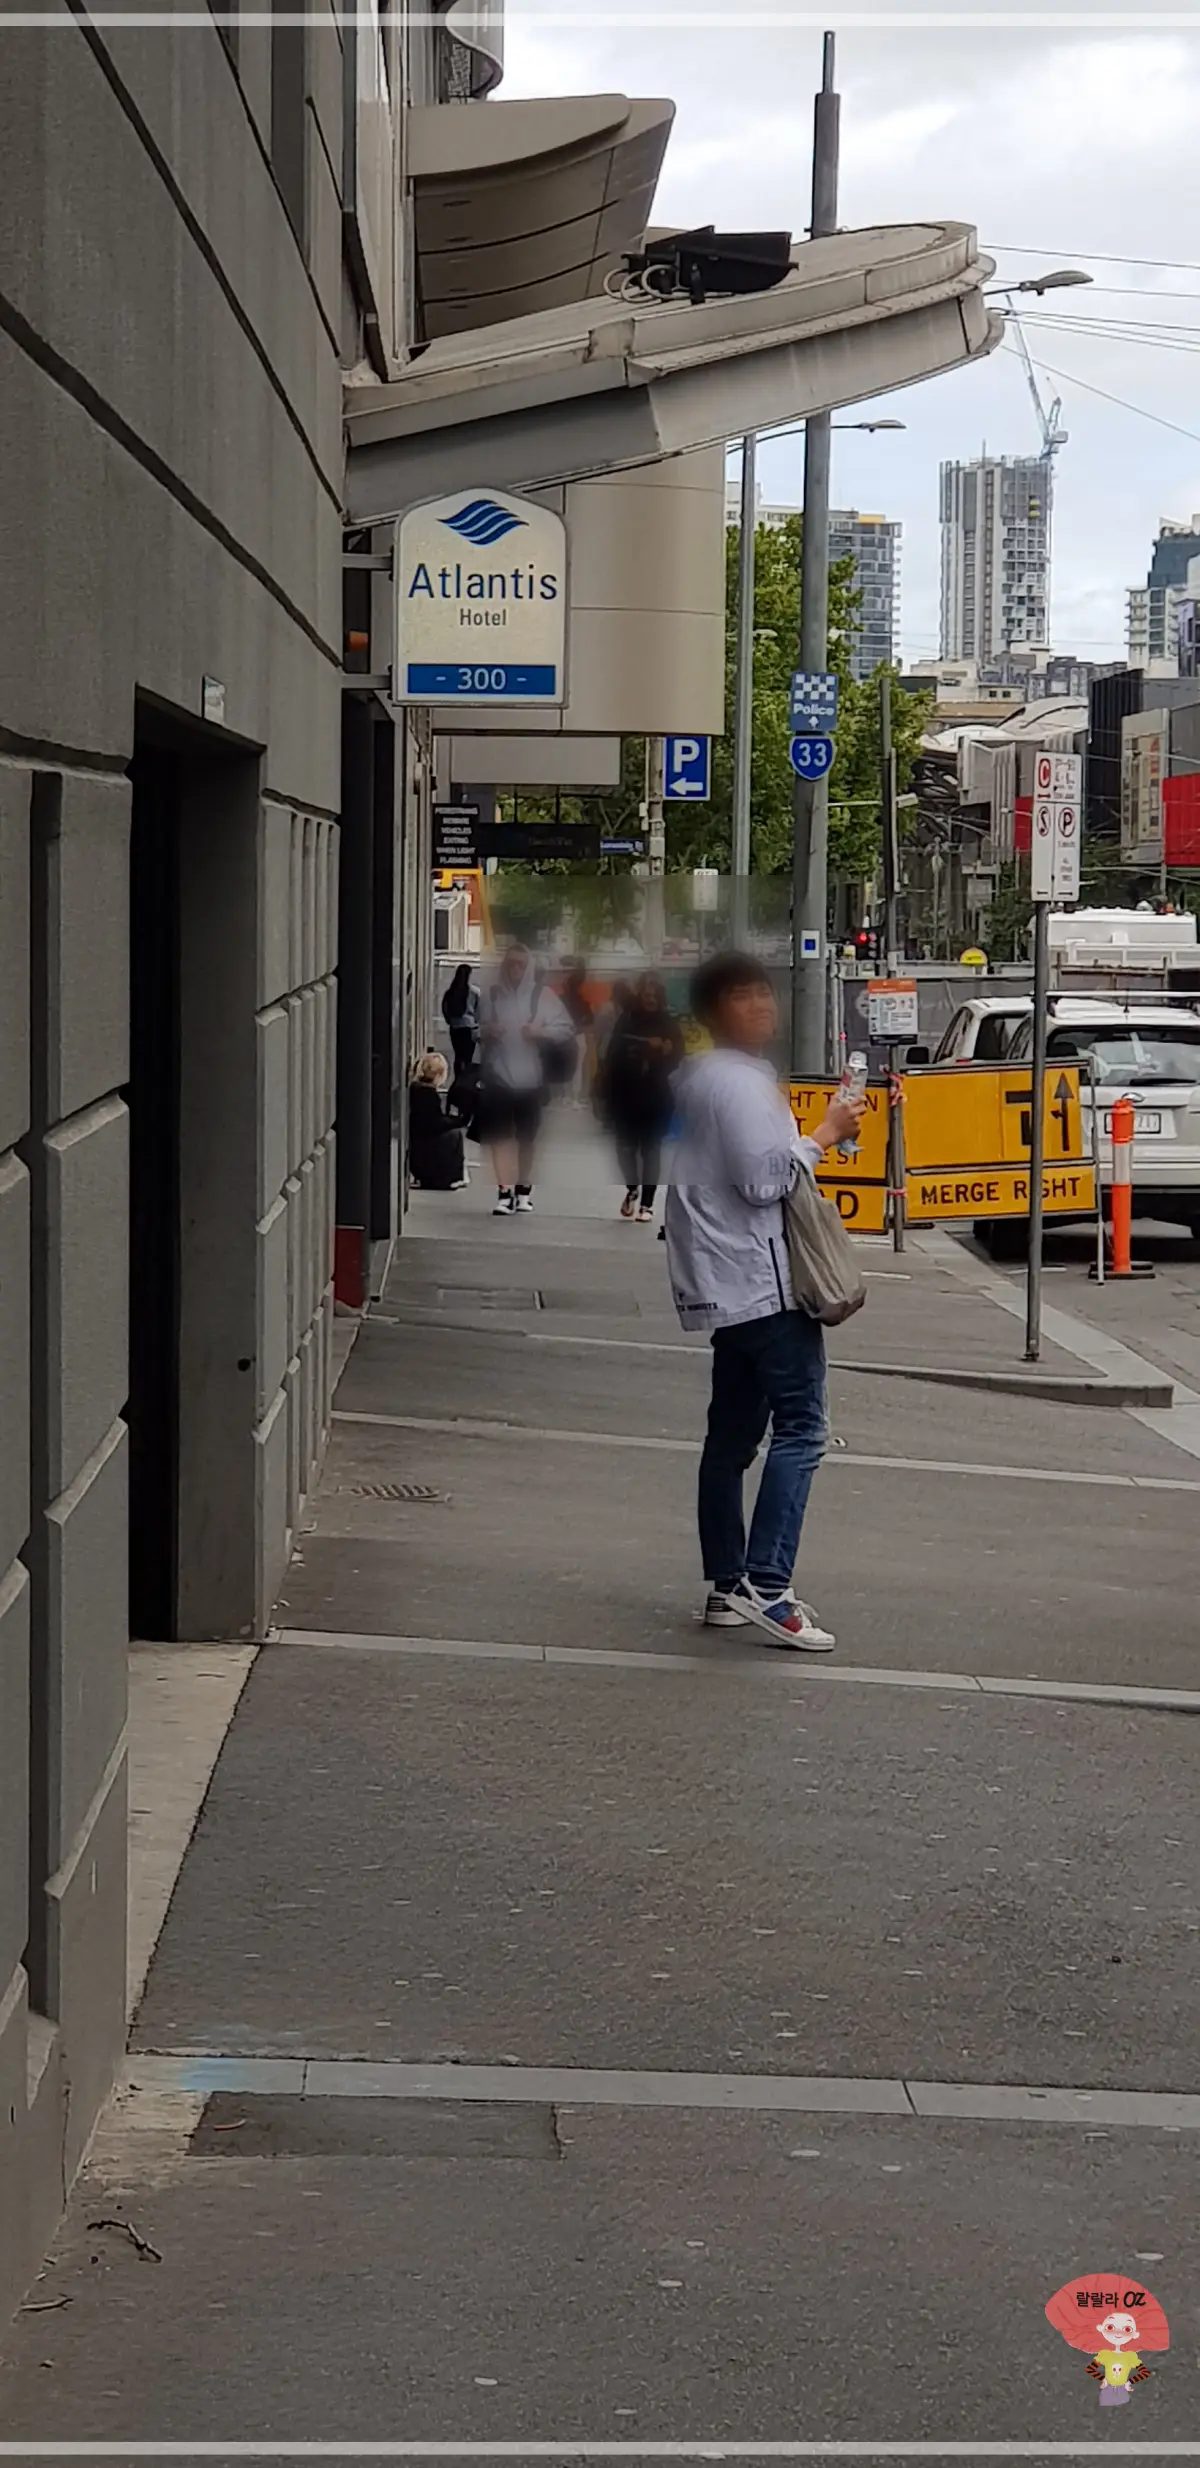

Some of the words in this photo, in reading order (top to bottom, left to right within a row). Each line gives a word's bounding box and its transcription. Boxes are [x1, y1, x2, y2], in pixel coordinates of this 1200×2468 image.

[408, 563, 557, 600] Atlantis
[459, 608, 507, 626] Hotel
[457, 668, 506, 690] 300
[793, 703, 834, 716] Police
[673, 739, 700, 773] P
[798, 742, 827, 767] 33
[822, 1091, 878, 1112] TN
[921, 1182, 1000, 1205] MERGE
[1014, 1177, 1081, 1200] RGHT
